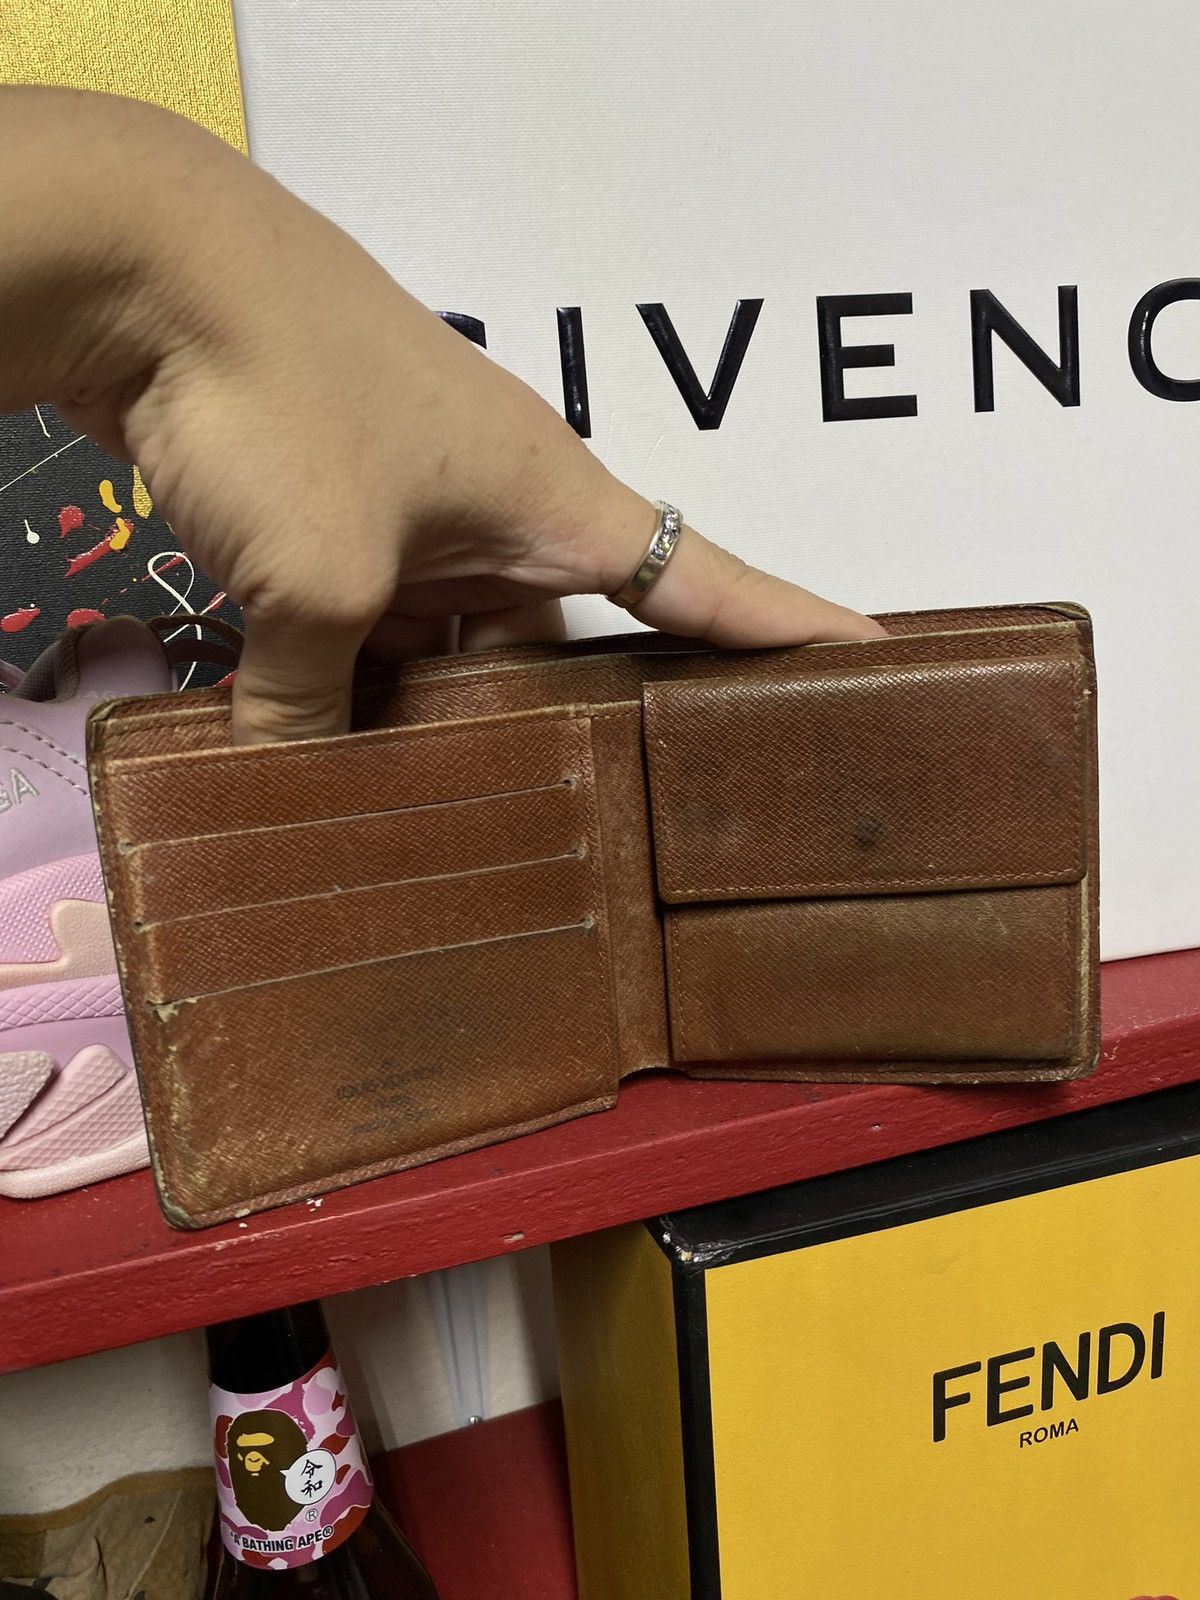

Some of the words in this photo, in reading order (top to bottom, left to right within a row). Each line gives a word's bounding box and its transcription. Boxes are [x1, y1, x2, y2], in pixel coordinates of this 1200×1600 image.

[435, 278, 1200, 438] IVENC
[933, 1311, 1165, 1442] FENDI
[1019, 1418, 1079, 1448] ROMA
[301, 1459, 323, 1497] 令和
[242, 1537, 294, 1551] BATHING
